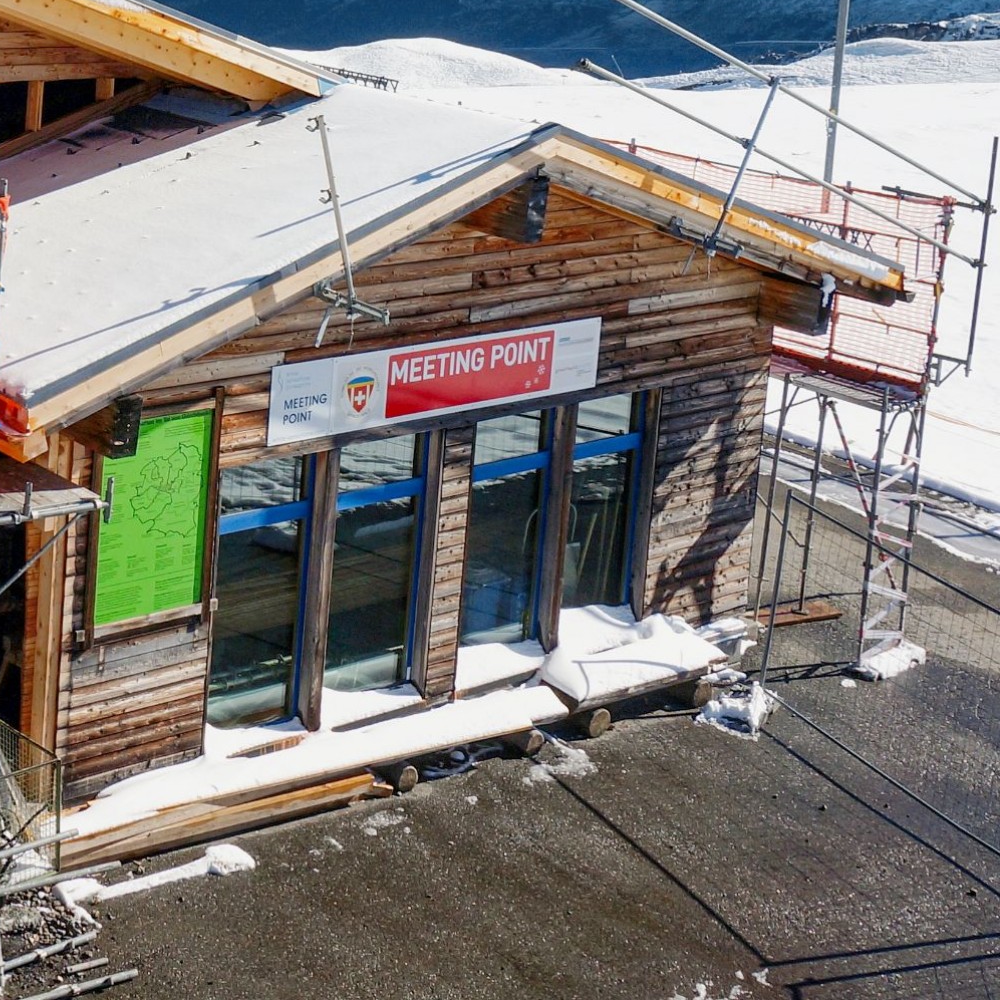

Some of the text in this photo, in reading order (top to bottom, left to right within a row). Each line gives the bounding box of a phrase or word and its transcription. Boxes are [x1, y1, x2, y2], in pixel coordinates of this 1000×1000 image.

[390, 337, 551, 386] MEETING POINT
[283, 393, 328, 411] MEETING
[282, 410, 313, 426] POINT
